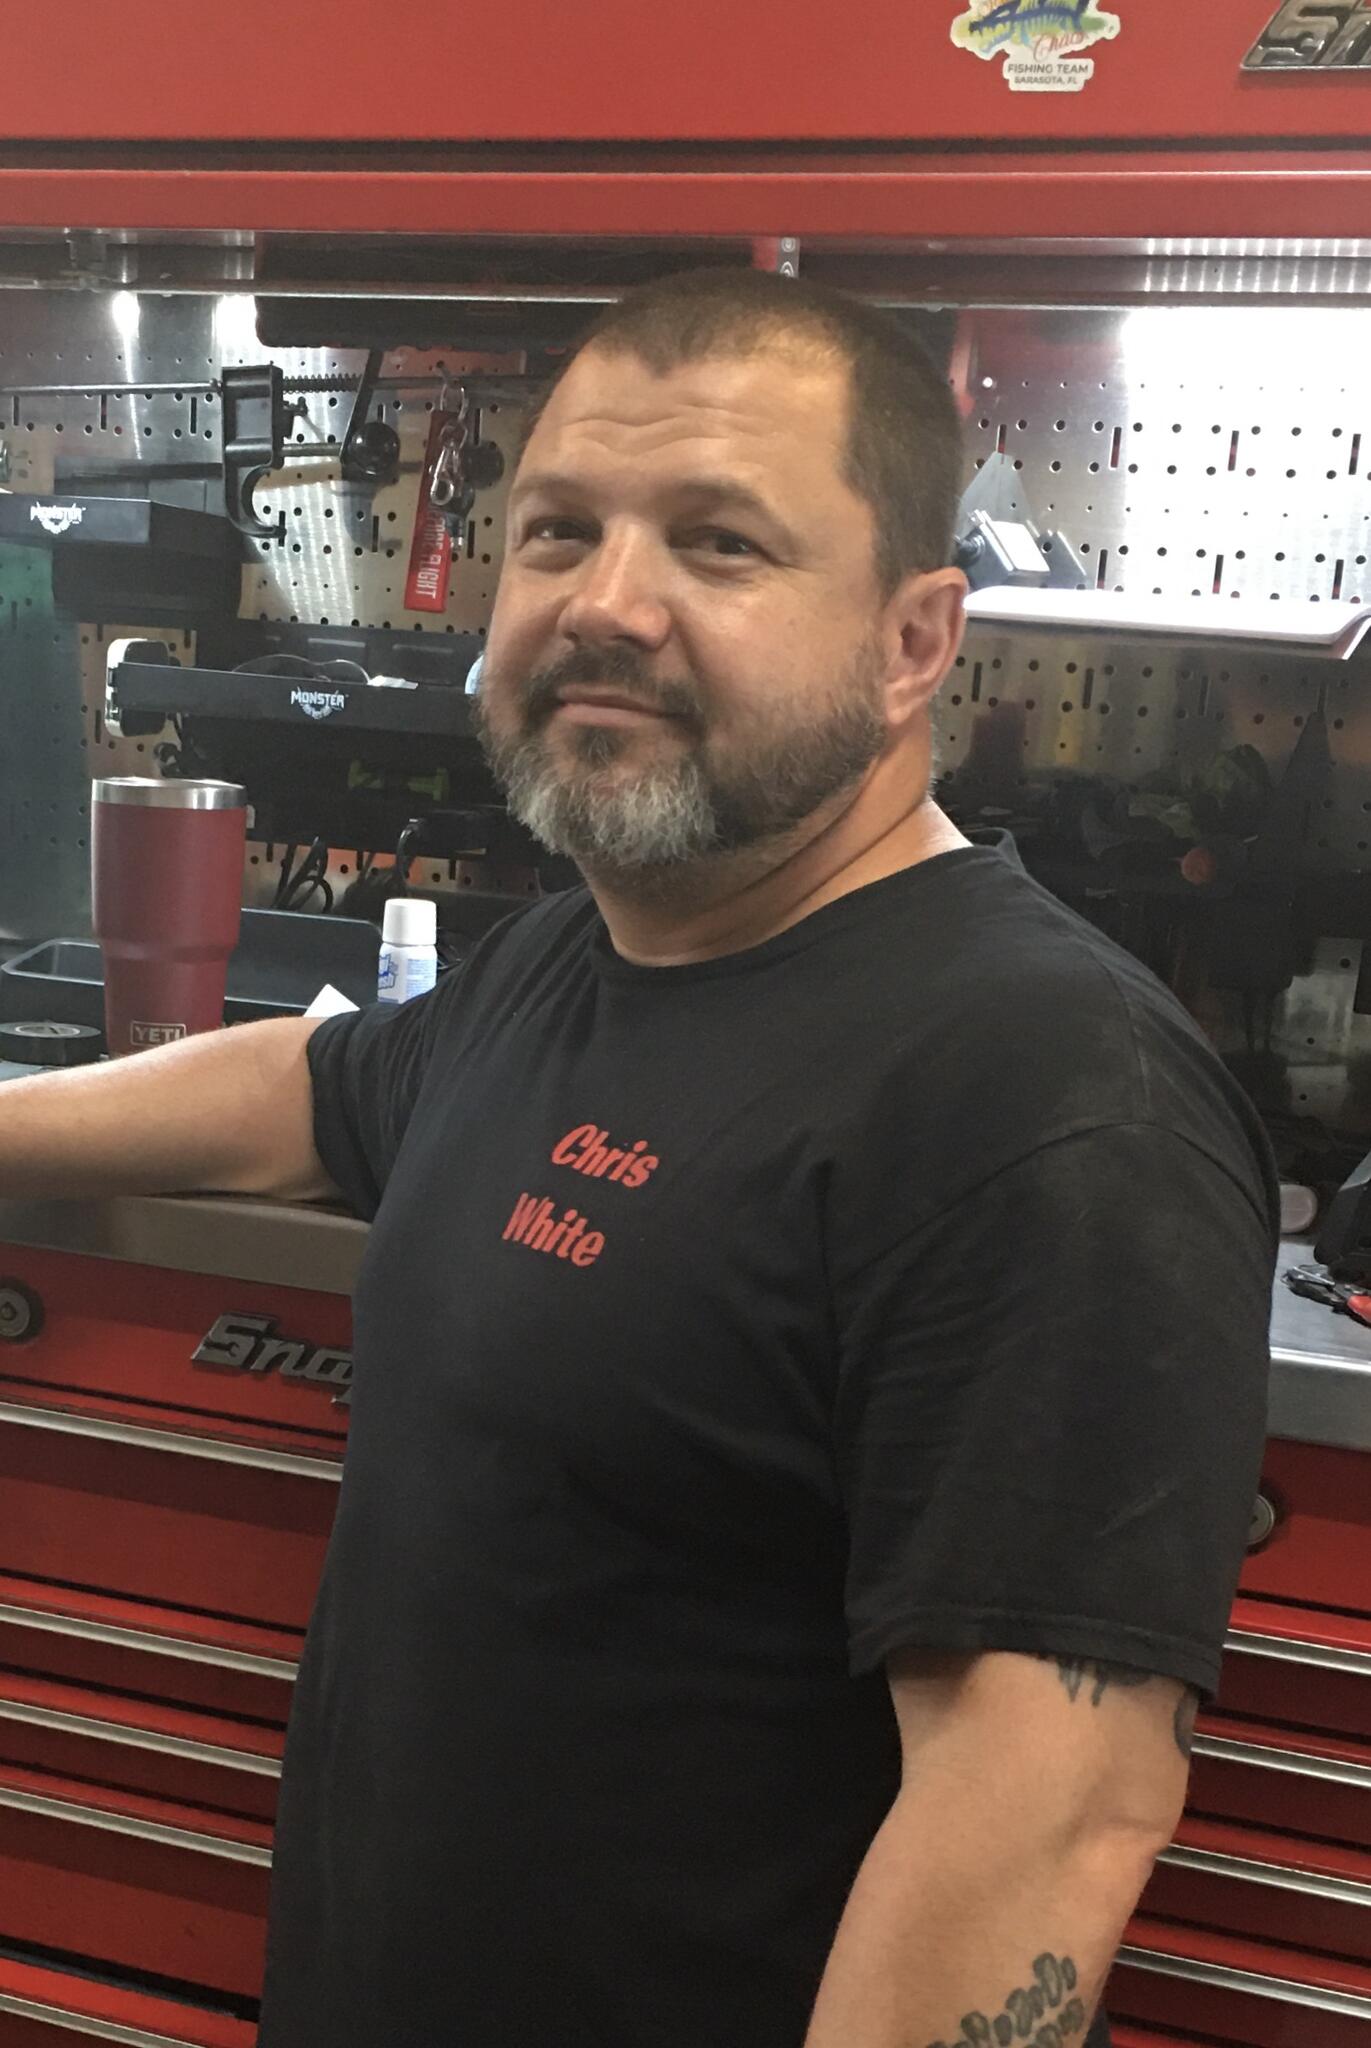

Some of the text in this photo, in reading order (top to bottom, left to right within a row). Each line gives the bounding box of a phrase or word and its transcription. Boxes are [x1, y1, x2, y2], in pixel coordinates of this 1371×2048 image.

[1007, 63, 1089, 74] FISHING TEAM
[415, 553, 442, 600] FLIGHT
[290, 686, 345, 709] MONSTER
[134, 1026, 181, 1042] YETI
[550, 1123, 660, 1188] Chris
[501, 1192, 606, 1267] White
[190, 1313, 352, 1404] Sna
